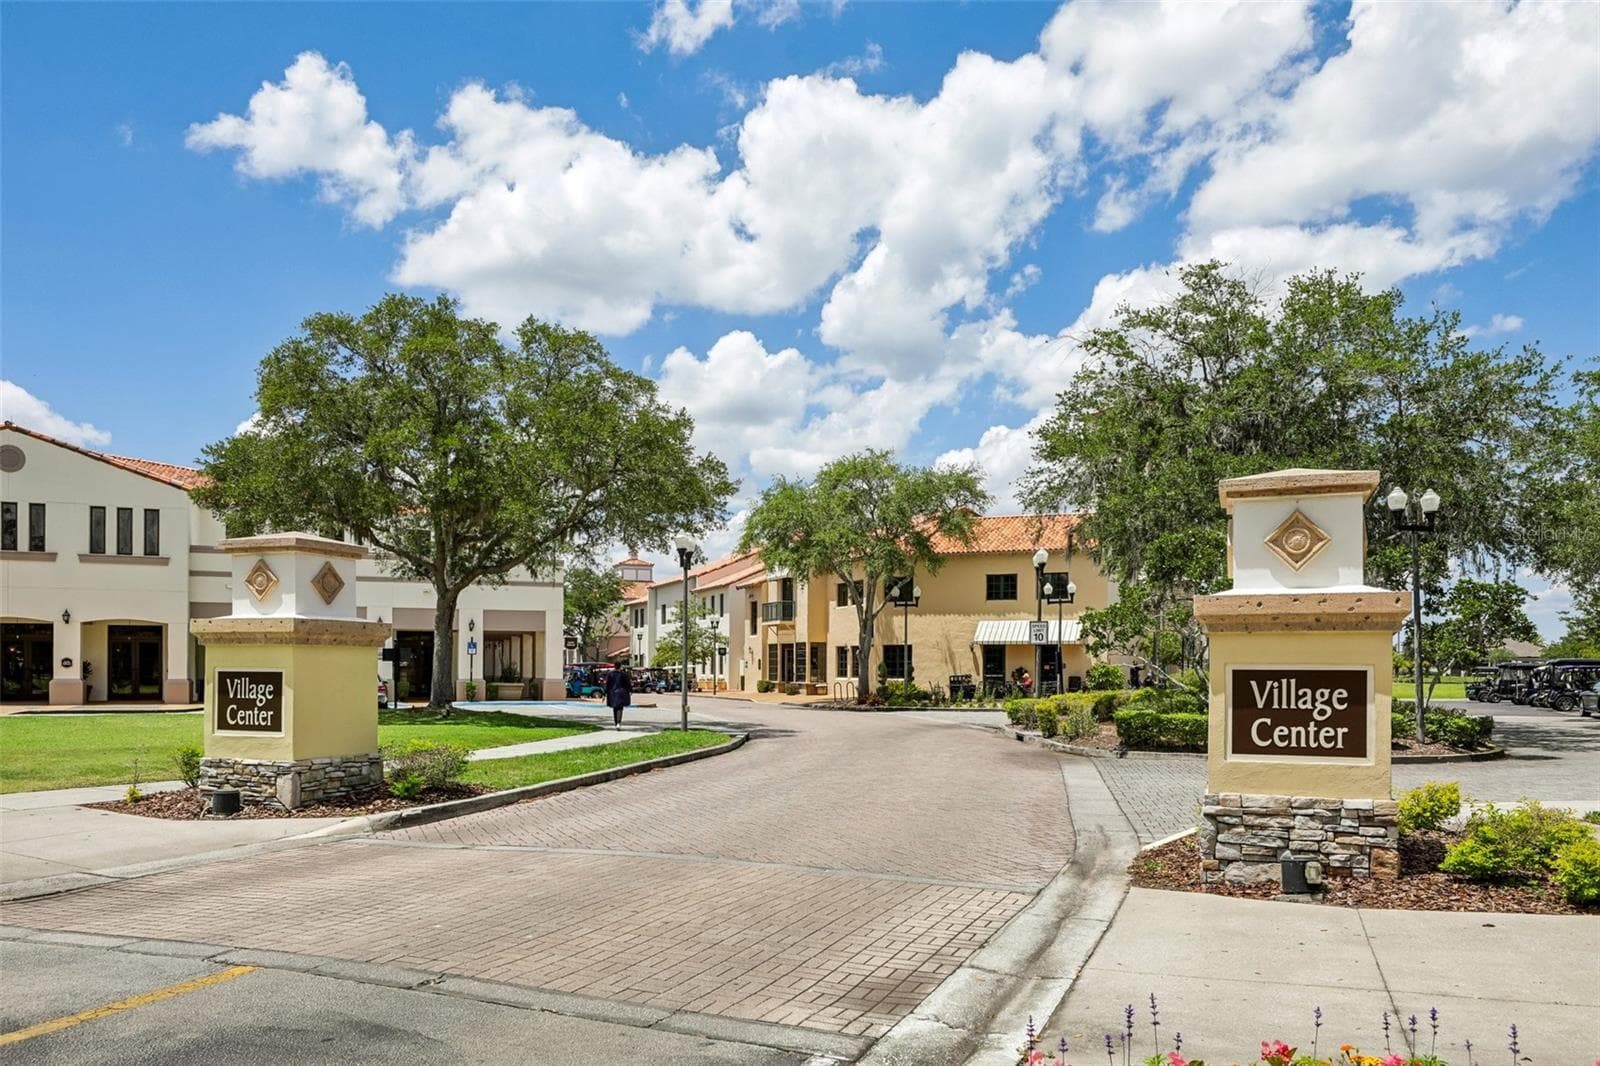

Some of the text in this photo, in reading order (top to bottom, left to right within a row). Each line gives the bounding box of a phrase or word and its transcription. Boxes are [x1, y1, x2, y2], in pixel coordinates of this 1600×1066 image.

[1033, 633, 1044, 642] 10
[226, 677, 274, 707] Village
[1249, 678, 1349, 721] Village
[226, 704, 274, 726] Center
[1250, 717, 1349, 749] Center
